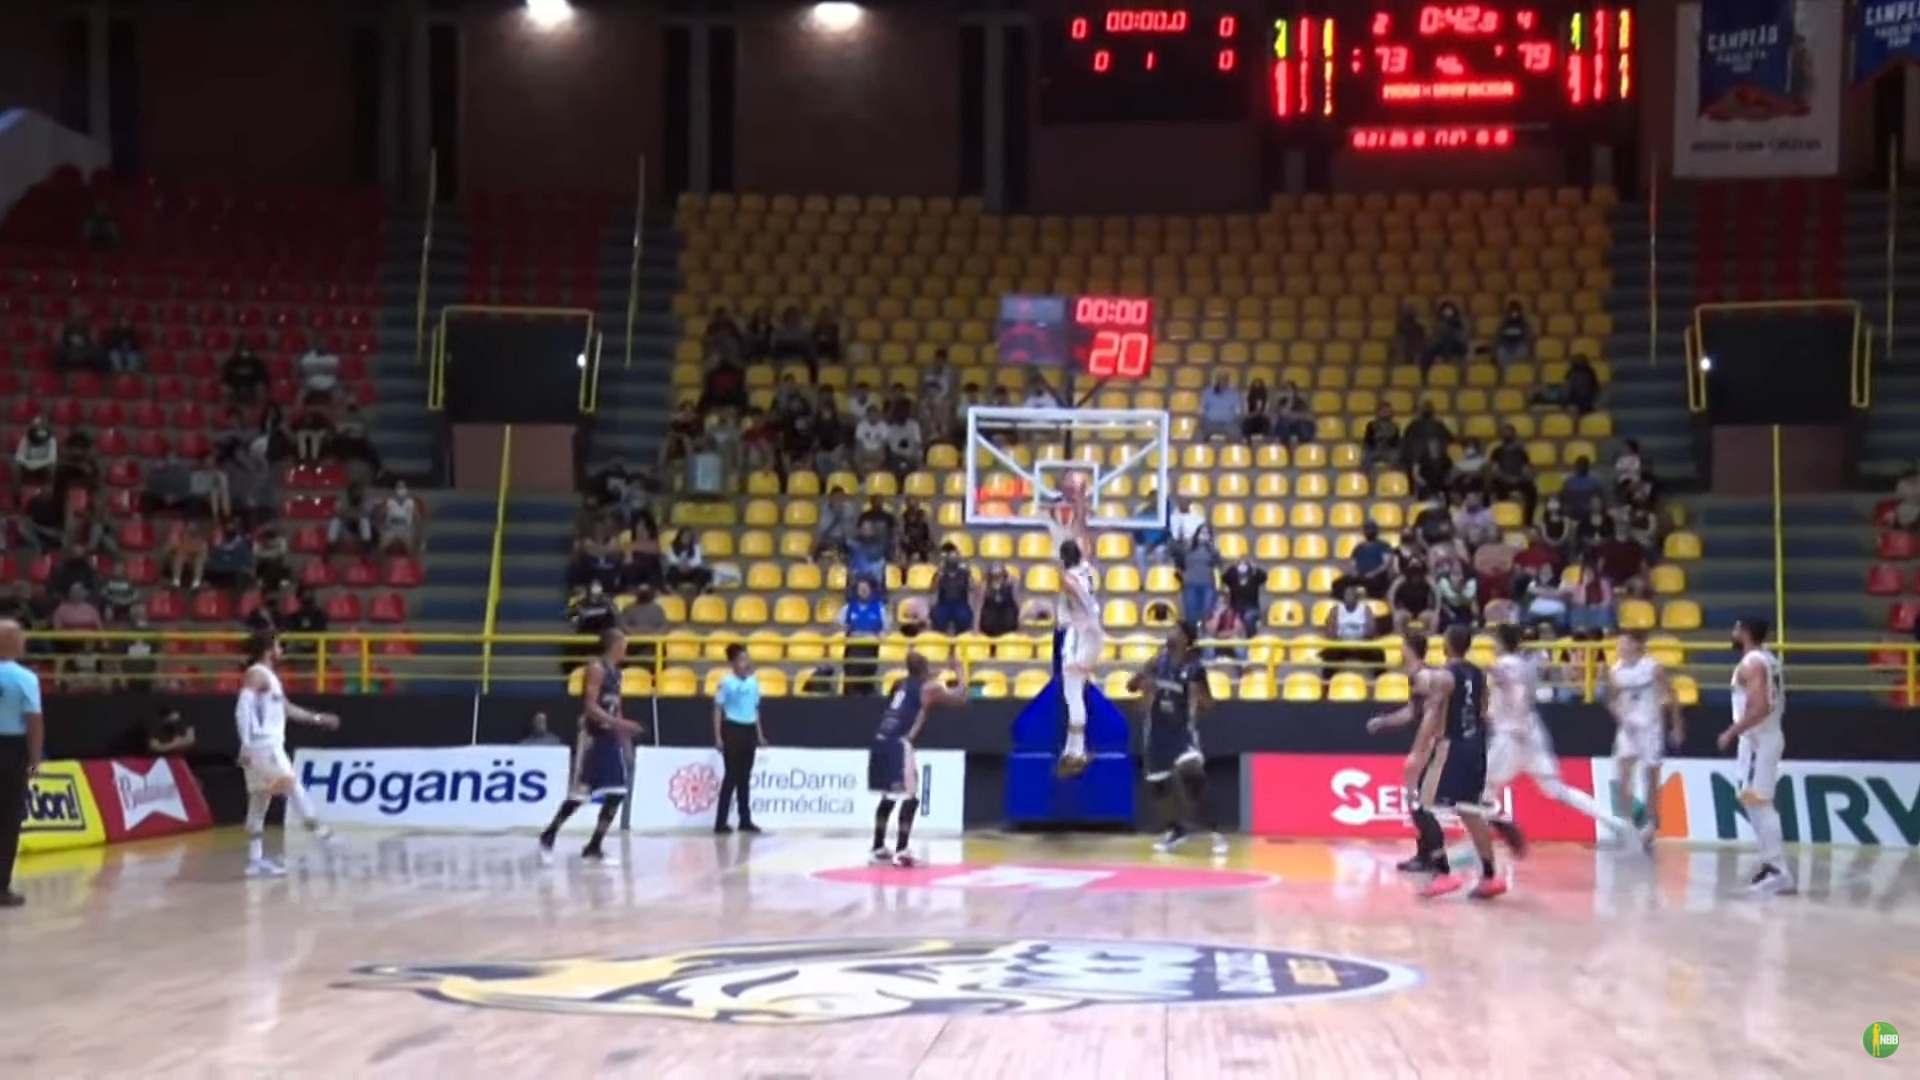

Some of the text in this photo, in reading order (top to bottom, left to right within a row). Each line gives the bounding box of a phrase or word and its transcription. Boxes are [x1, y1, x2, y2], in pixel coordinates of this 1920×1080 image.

[1072, 18, 1087, 39] 0
[1106, 11, 1187, 32] 00:00.0
[1219, 17, 1234, 37] 0
[1094, 51, 1109, 71] 0
[1219, 50, 1234, 70] 0
[1375, 46, 1408, 72] 73
[1518, 43, 1551, 70] 79
[1076, 298, 1148, 323] 00:00
[1089, 331, 1148, 375] 20
[302, 760, 547, 815] Höganäs
[750, 768, 857, 790] otreDame
